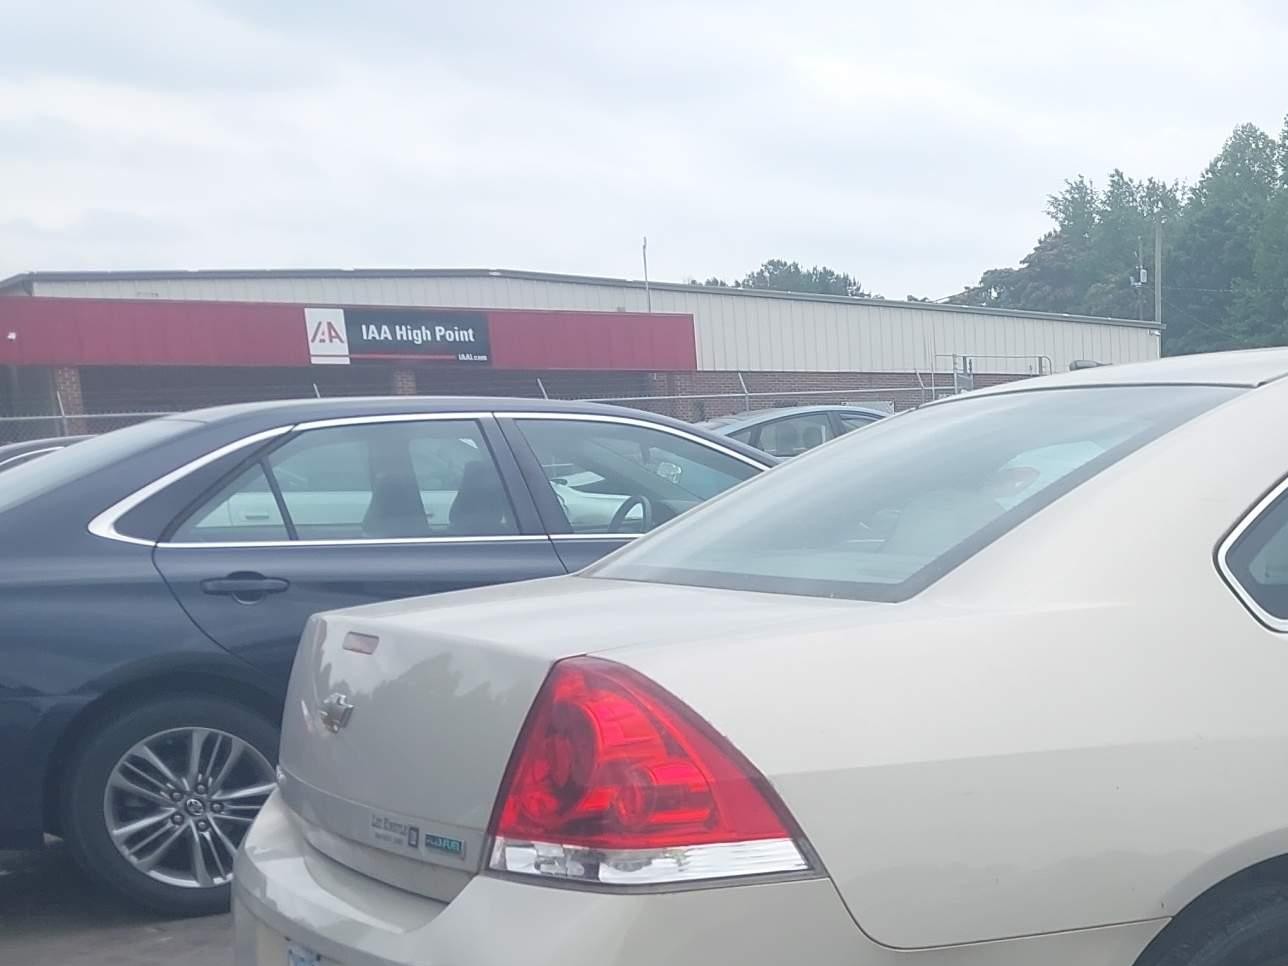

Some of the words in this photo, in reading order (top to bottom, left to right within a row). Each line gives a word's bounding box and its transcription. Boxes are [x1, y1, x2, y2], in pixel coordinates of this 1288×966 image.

[361, 324, 392, 340] IAA
[395, 325, 431, 345] High
[435, 326, 475, 342] Point
